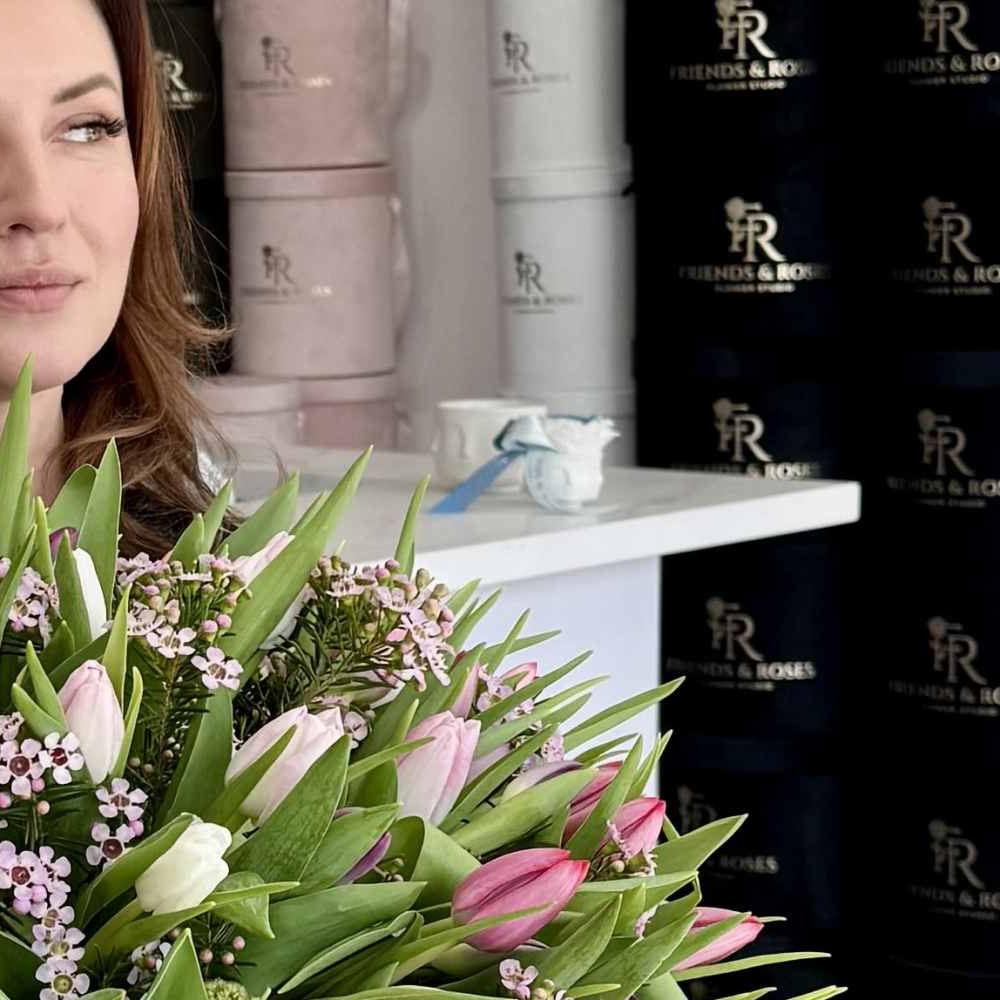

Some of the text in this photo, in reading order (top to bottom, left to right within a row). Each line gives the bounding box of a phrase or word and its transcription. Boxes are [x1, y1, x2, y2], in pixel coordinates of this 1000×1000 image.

[748, 60, 766, 79] &
[757, 262, 775, 282] &
[755, 660, 817, 681] ROSES
[719, 855, 780, 875] ROSES
